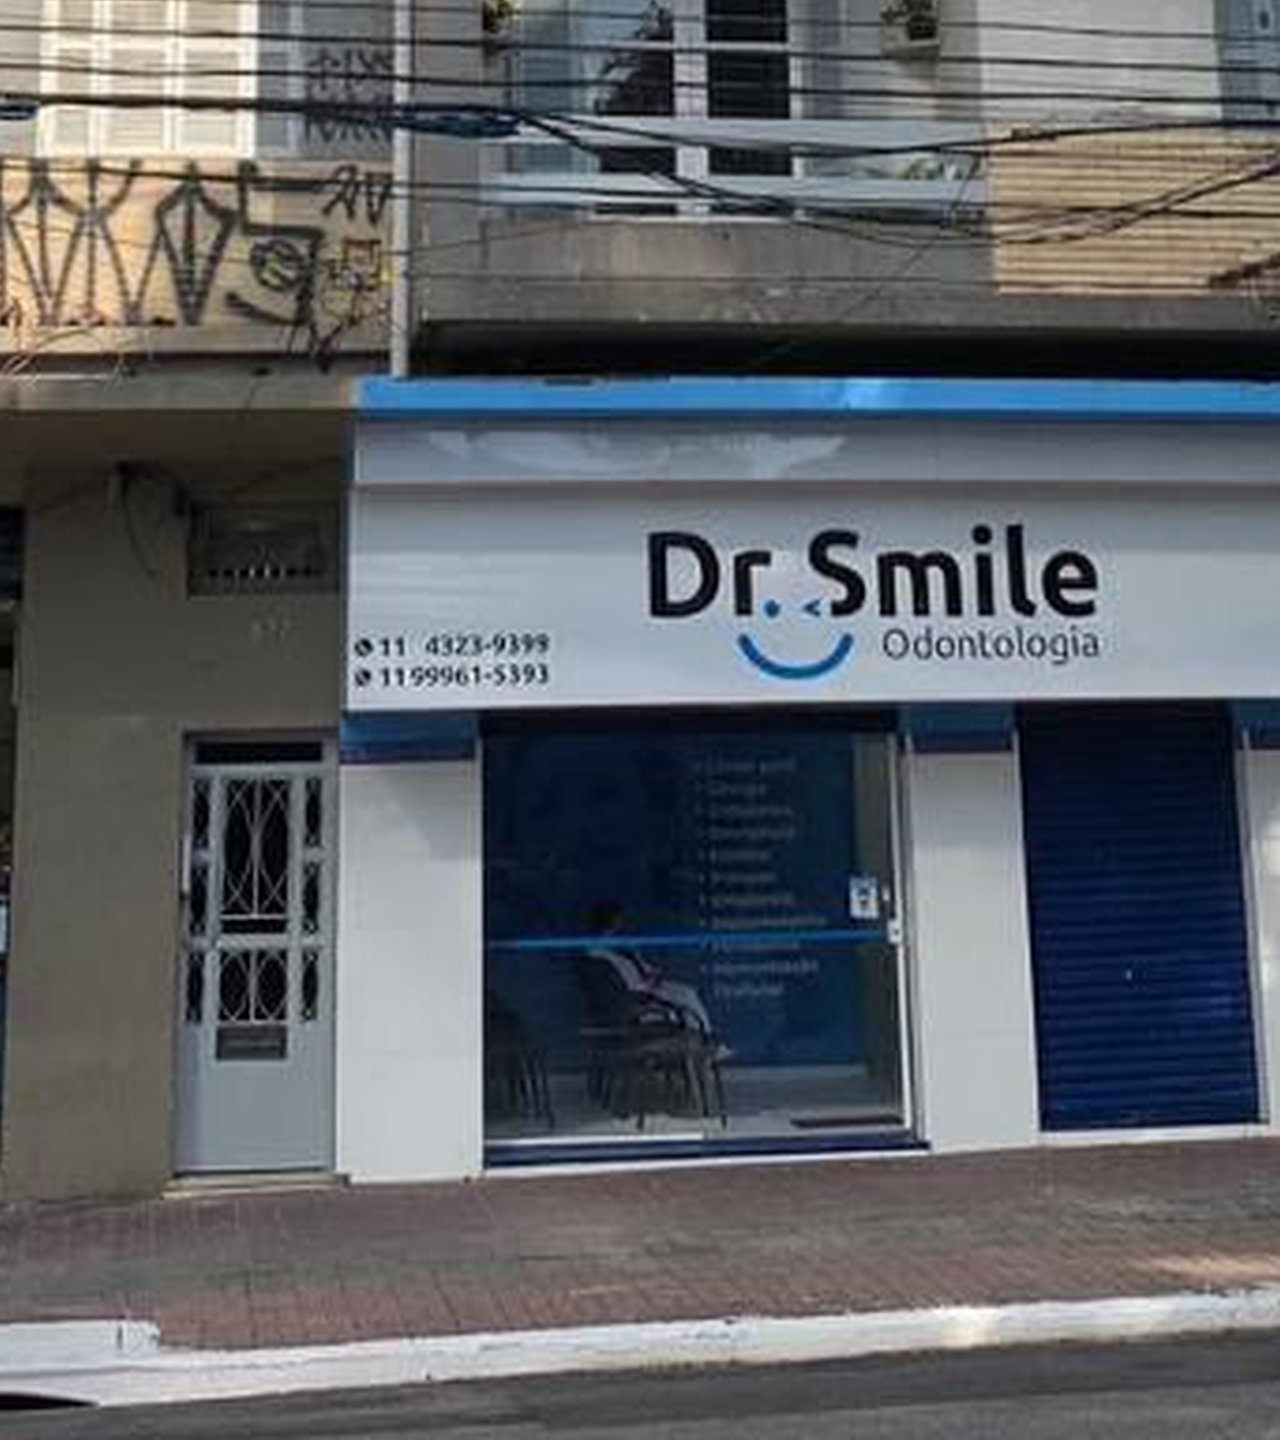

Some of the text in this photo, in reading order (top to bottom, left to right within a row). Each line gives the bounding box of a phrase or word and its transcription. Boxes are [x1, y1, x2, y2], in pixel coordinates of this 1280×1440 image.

[808, 525, 1099, 617] Smile
[381, 636, 406, 657] 11
[883, 627, 1100, 665] Odontologia
